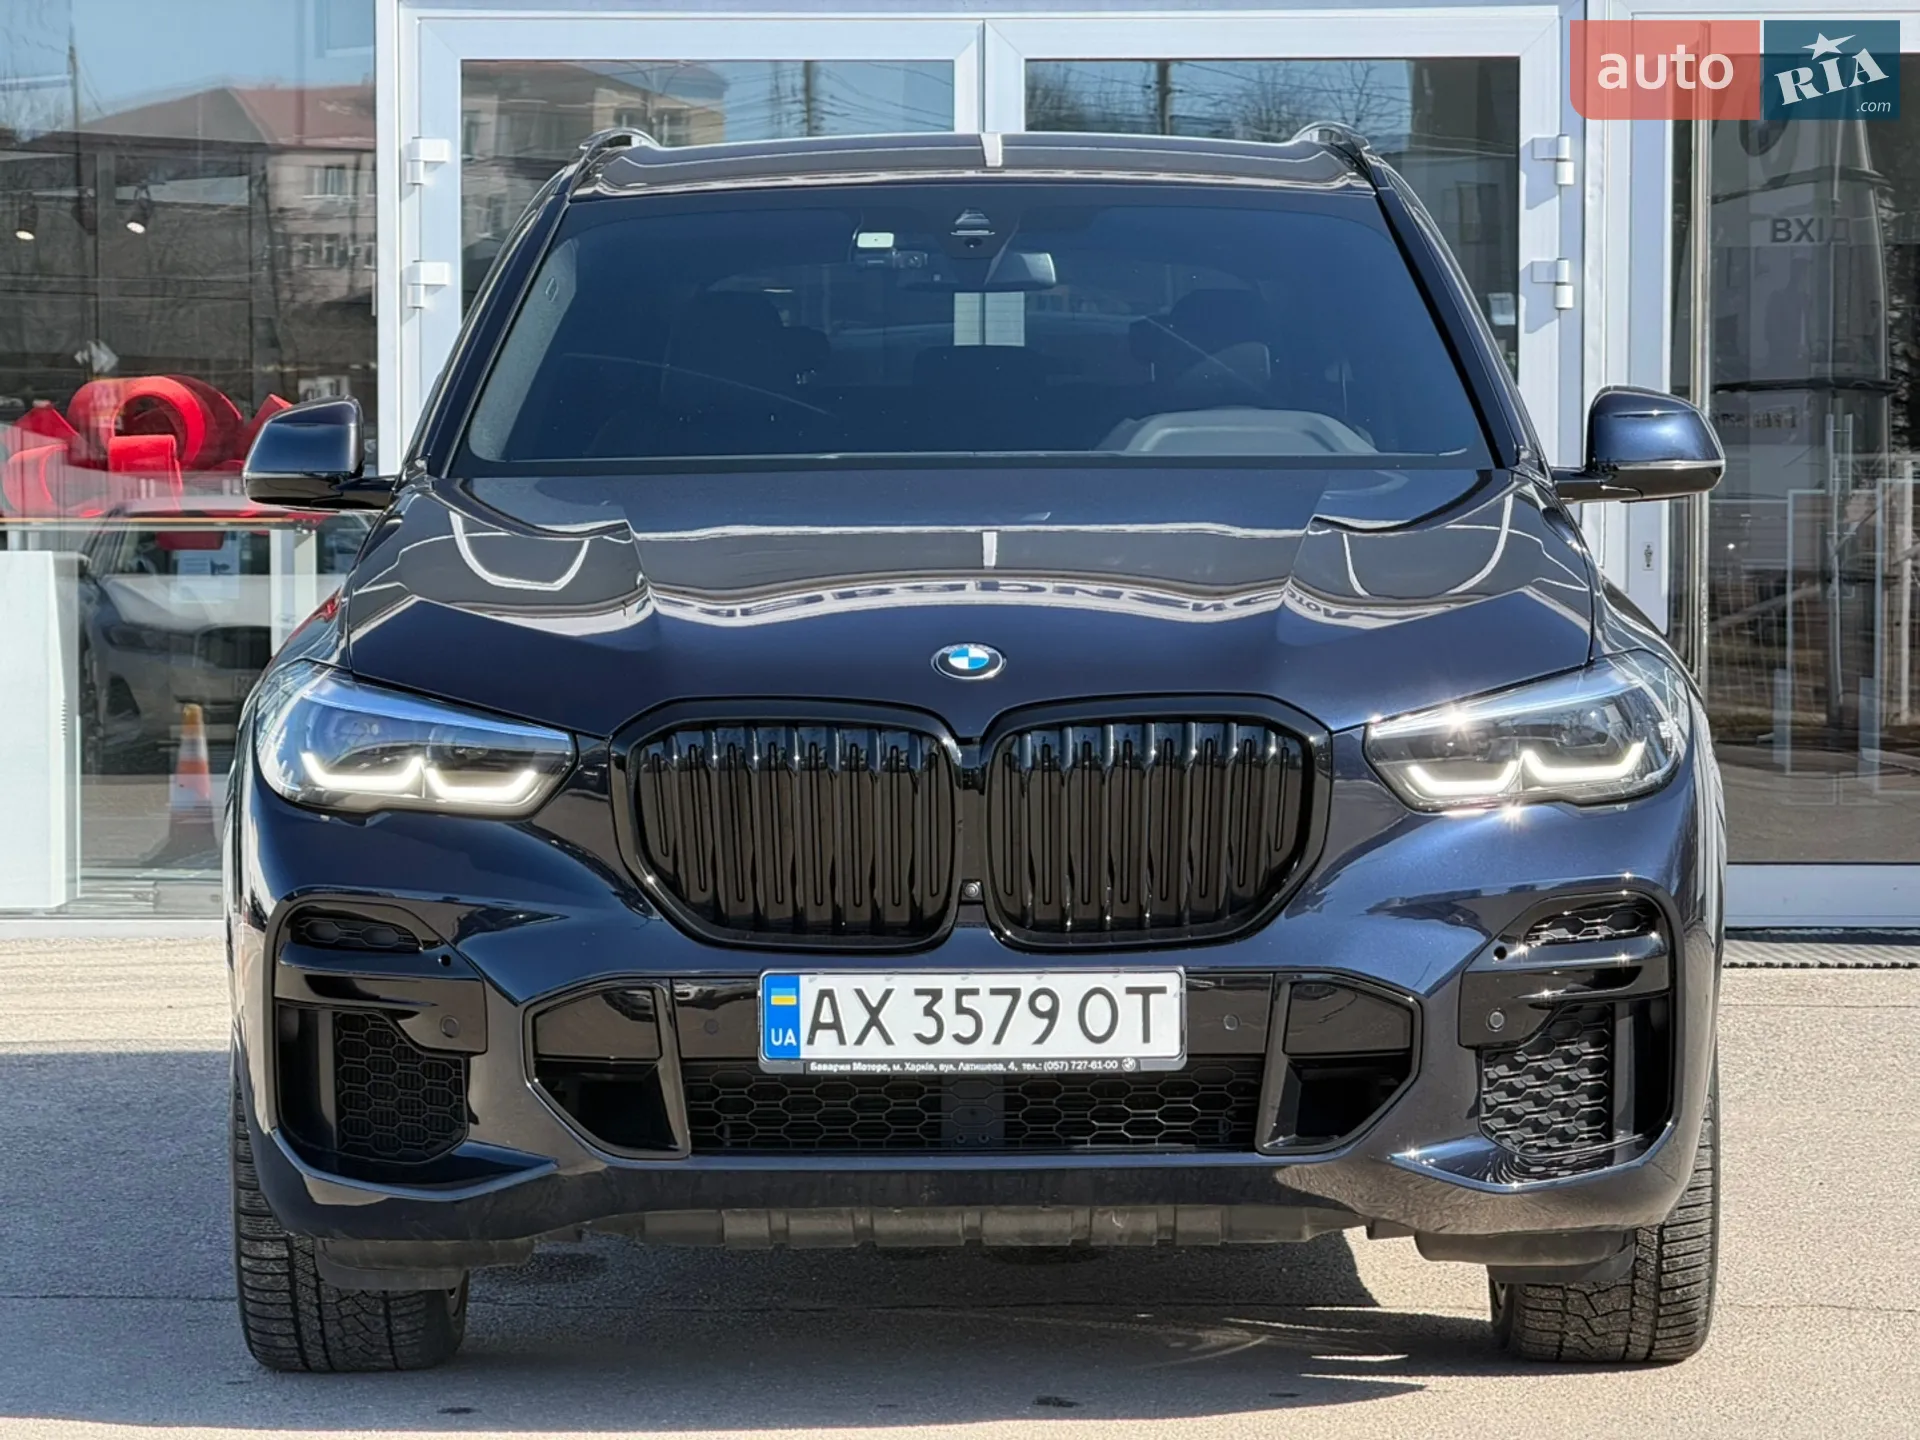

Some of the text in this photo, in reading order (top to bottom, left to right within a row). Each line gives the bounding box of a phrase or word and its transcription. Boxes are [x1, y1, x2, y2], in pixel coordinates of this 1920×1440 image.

[1770, 217, 1851, 247] ВХІД
[806, 985, 1168, 1046] AX 3579 OT
[771, 1028, 797, 1047] UA
[1043, 1060, 1068, 1071] (057)
